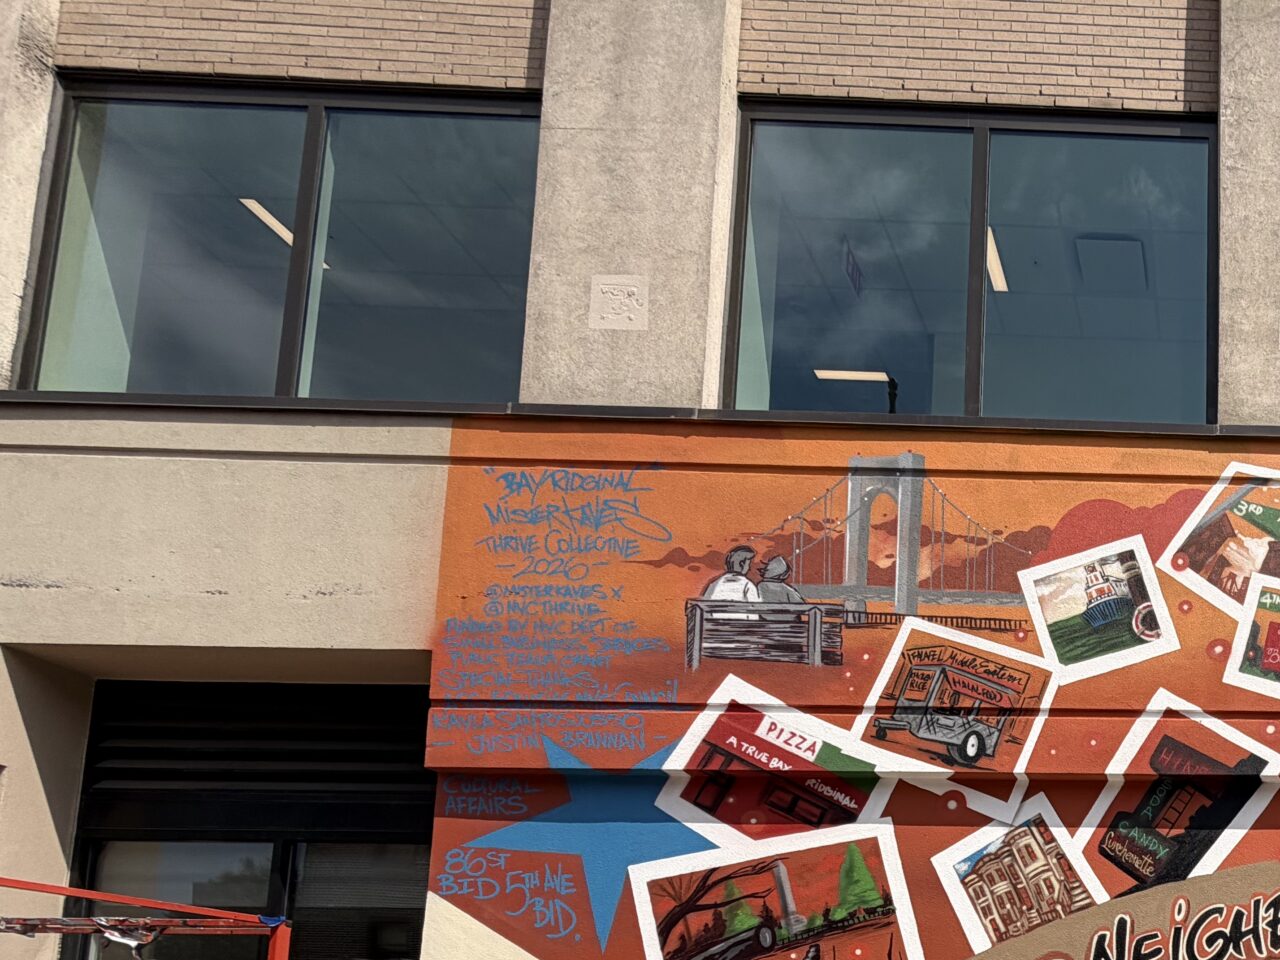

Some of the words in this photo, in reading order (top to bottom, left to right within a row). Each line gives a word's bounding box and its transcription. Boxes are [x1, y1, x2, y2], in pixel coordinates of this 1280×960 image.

[1233, 499, 1264, 517] 3RD
[474, 531, 540, 554] THRIVE
[726, 735, 738, 749] A
[740, 741, 770, 764] TRUE
[766, 720, 818, 758] PIZZA
[443, 795, 529, 816] AFFAIRS
[1117, 820, 1169, 859] CANDY
[444, 848, 487, 877] 86
[437, 873, 501, 900] BID
[543, 863, 576, 895] AVE
